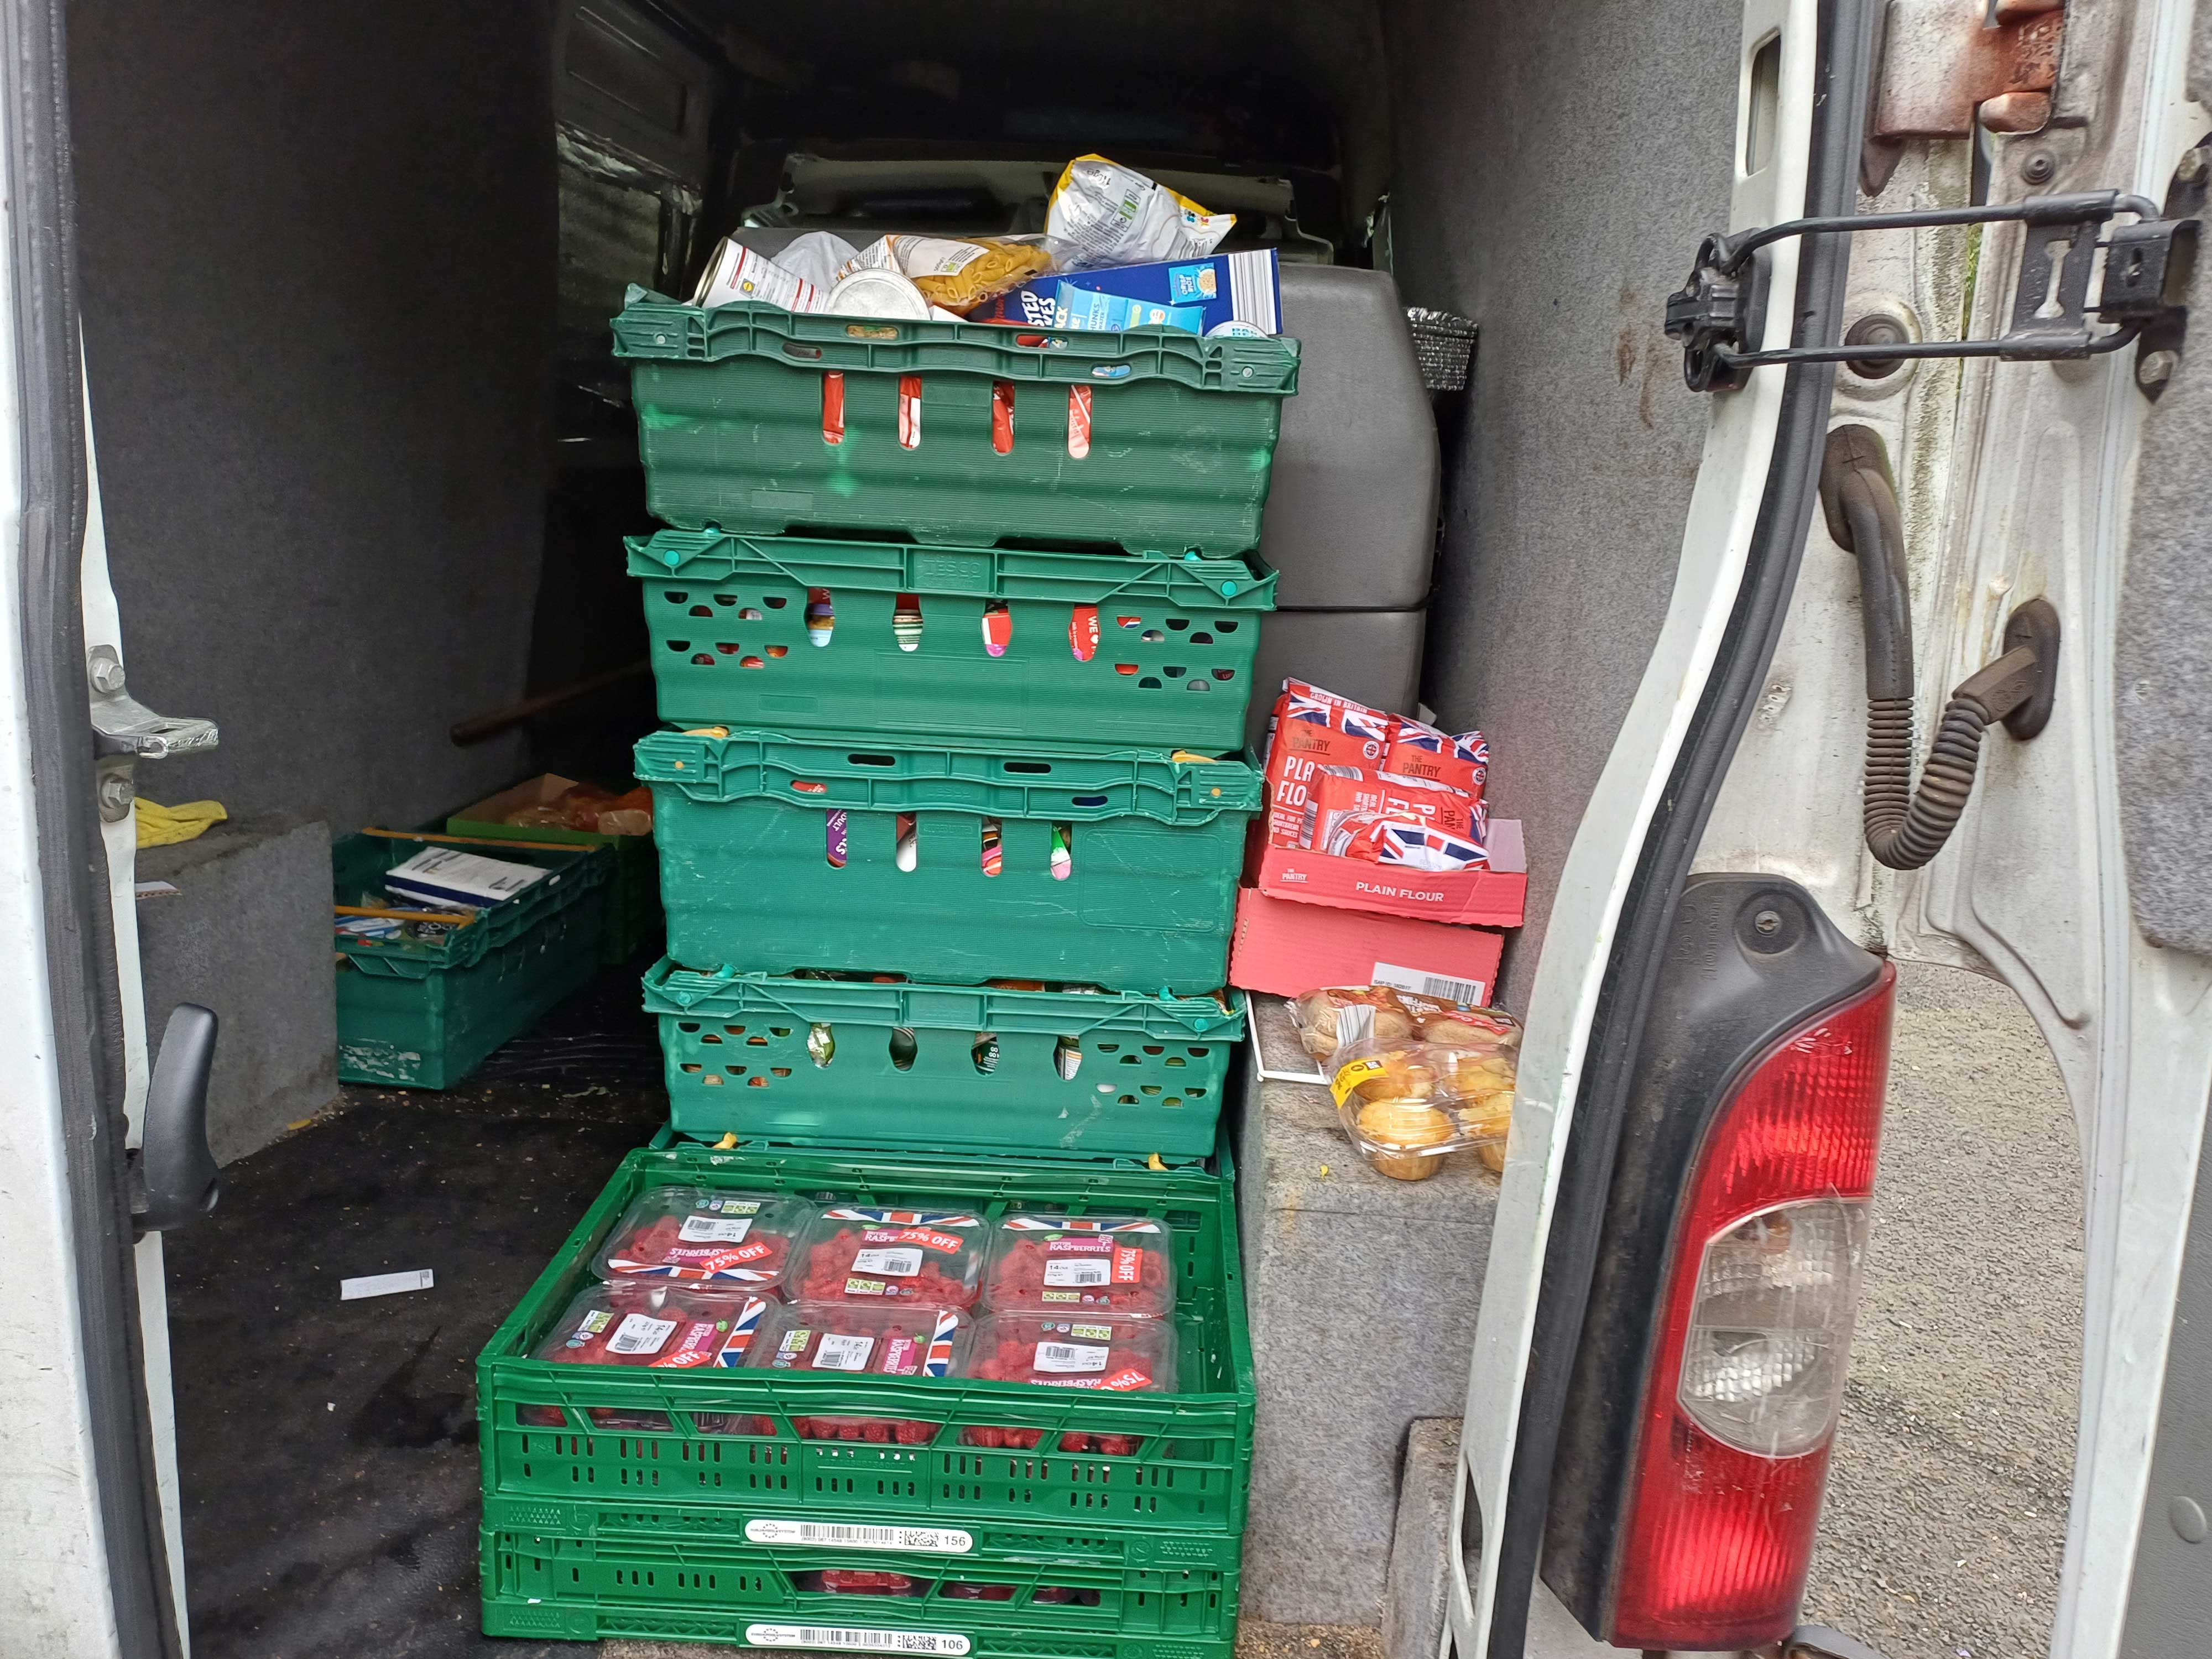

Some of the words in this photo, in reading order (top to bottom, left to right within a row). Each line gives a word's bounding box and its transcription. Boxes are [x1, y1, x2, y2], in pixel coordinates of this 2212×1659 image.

[1088, 615, 1098, 633] WE
[1292, 737, 1331, 752] PANTRY
[1411, 754, 1423, 763] THE
[1284, 755, 1315, 782] PLA
[1403, 762, 1441, 778] PANTRY
[1276, 780, 1307, 806] FLO
[1455, 818, 1464, 830] THE
[1282, 873, 1307, 881] PANTRY
[1356, 881, 1396, 897] PLAIN
[1399, 889, 1444, 902] FLOUR
[900, 1232, 930, 1241] 75%
[931, 1236, 958, 1249] OFF
[1049, 1244, 1111, 1253] RASPBERRIES
[705, 1252, 739, 1271] 75%
[738, 1245, 765, 1261] OFF
[1120, 1249, 1136, 1265] 75%
[1118, 1266, 1135, 1281] OFF
[672, 1350, 701, 1365] OFF
[1110, 1372, 1145, 1389] 75%
[944, 1535, 966, 1547] 156
[941, 1639, 963, 1650] 106
